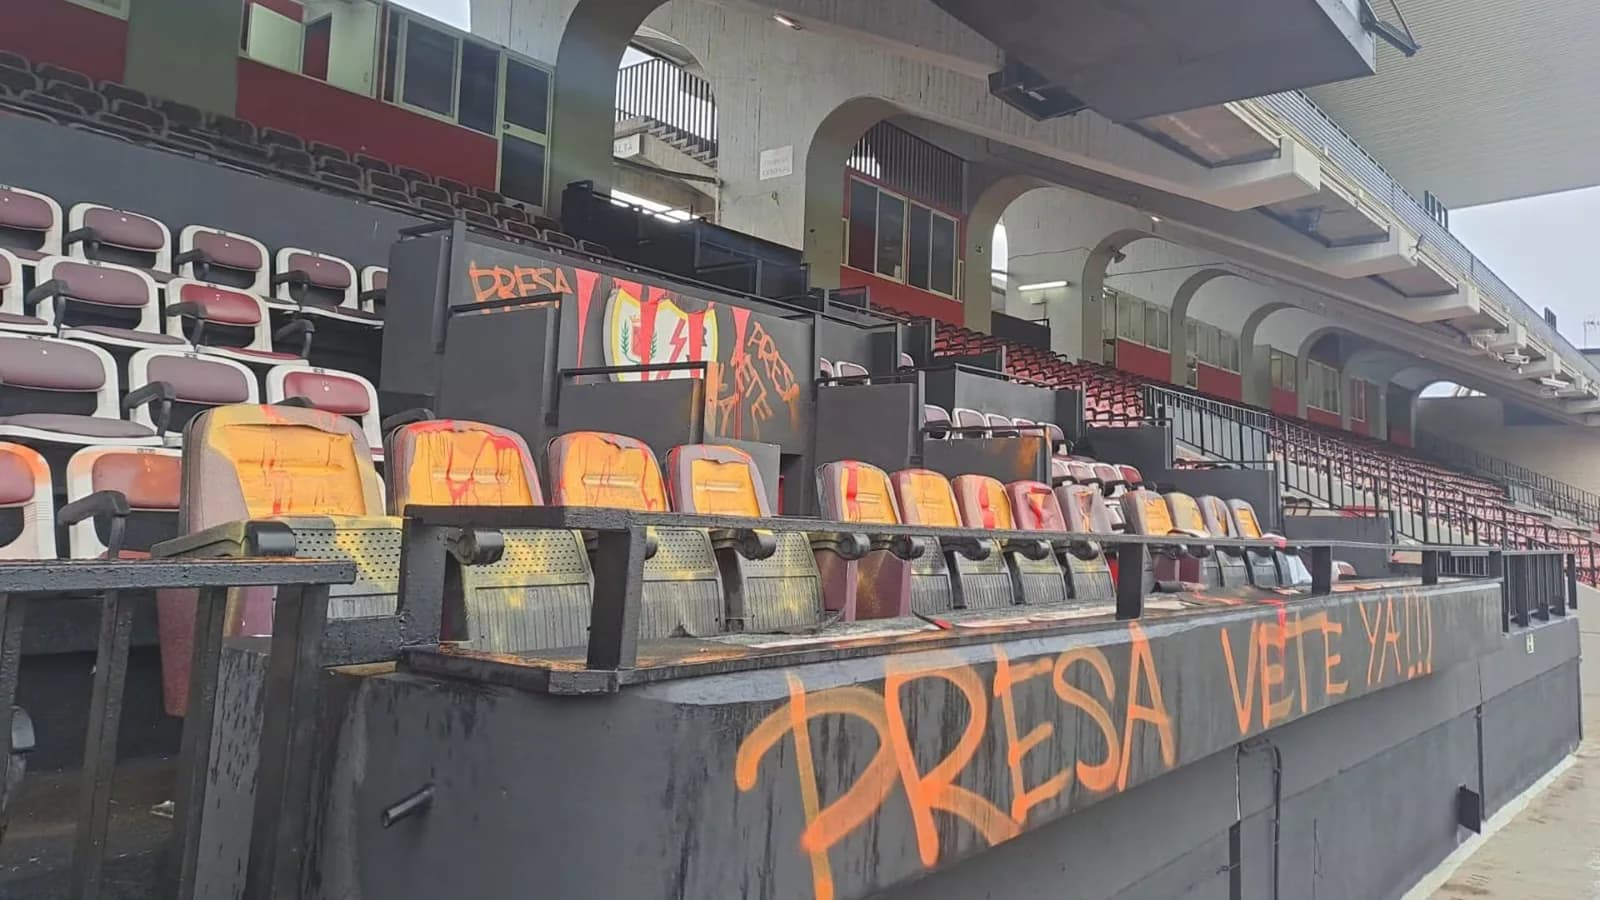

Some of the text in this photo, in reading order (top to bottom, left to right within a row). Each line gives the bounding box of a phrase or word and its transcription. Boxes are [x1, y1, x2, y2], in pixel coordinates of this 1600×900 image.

[468, 260, 573, 314] PRESA
[735, 621, 1175, 900] PRESA
[1220, 611, 1349, 735] VETE
